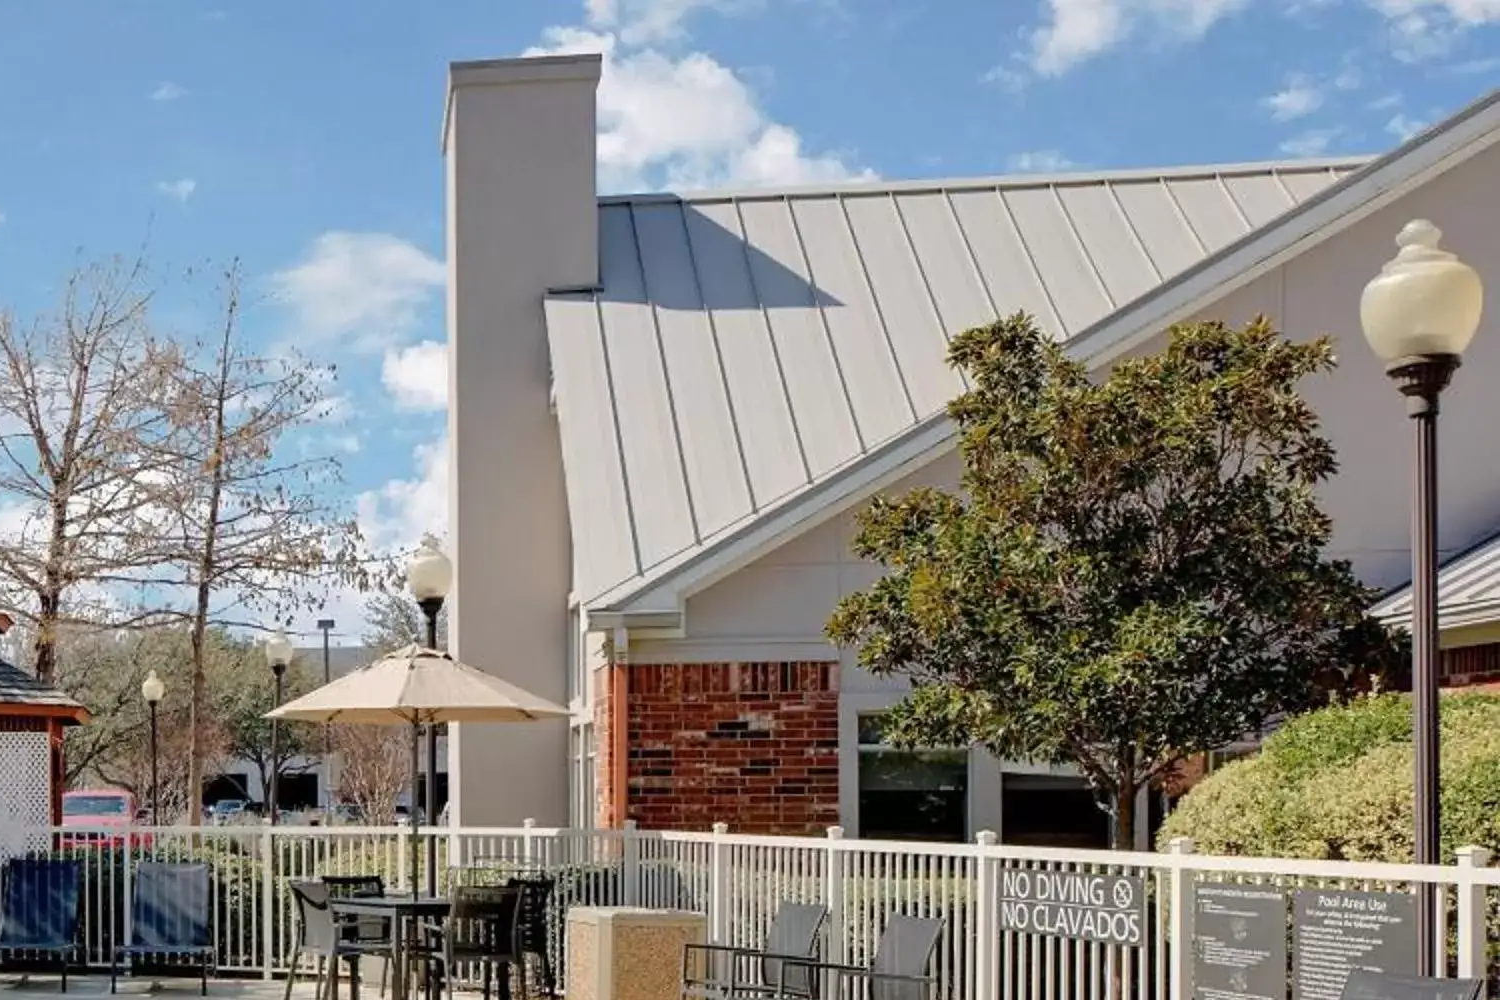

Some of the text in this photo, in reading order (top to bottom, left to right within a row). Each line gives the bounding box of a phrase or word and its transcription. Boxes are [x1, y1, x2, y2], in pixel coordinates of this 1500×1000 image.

[1003, 871, 1105, 905] NO DIVING
[1318, 895, 1388, 912] Pool Area Use
[1002, 901, 1140, 943] NO CLAVADOS
